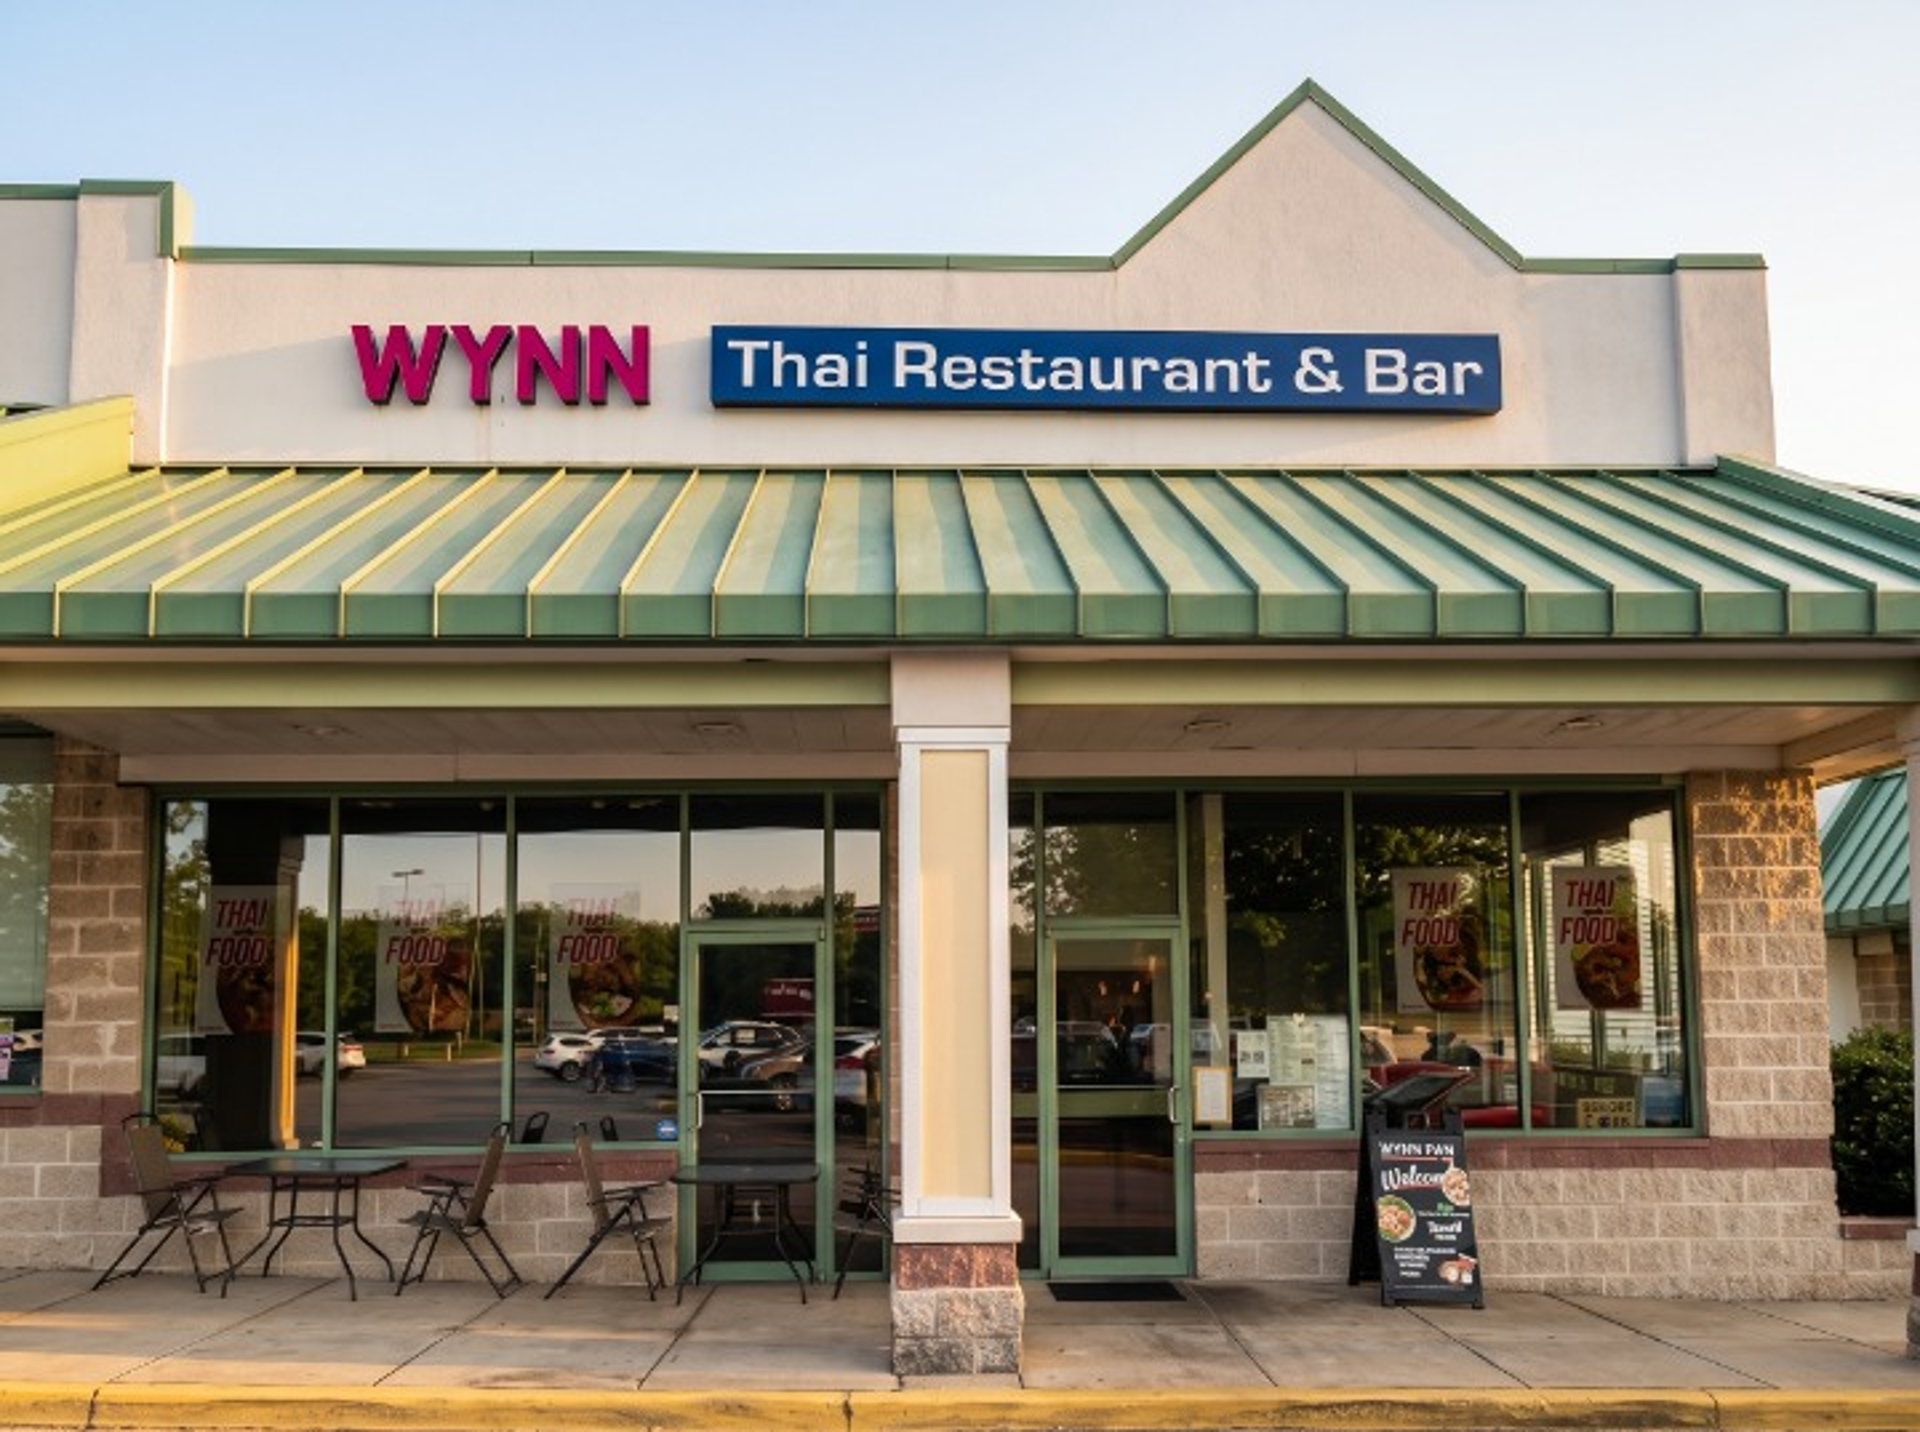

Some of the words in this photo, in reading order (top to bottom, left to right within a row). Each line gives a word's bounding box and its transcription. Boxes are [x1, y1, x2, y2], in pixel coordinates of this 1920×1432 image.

[352, 324, 651, 405] WYNN
[727, 339, 869, 390] Thai
[893, 342, 1272, 394] Restaurant
[1294, 347, 1344, 395] &
[1364, 348, 1485, 397] Bar
[1408, 881, 1457, 910] THAI
[1566, 880, 1614, 908] THAI
[214, 898, 268, 929] THAI
[1402, 917, 1459, 946] FOOD
[1560, 916, 1616, 945] FOOD
[205, 937, 267, 967] FOOD
[386, 935, 446, 965] FOOD
[557, 935, 617, 965] FOOD
